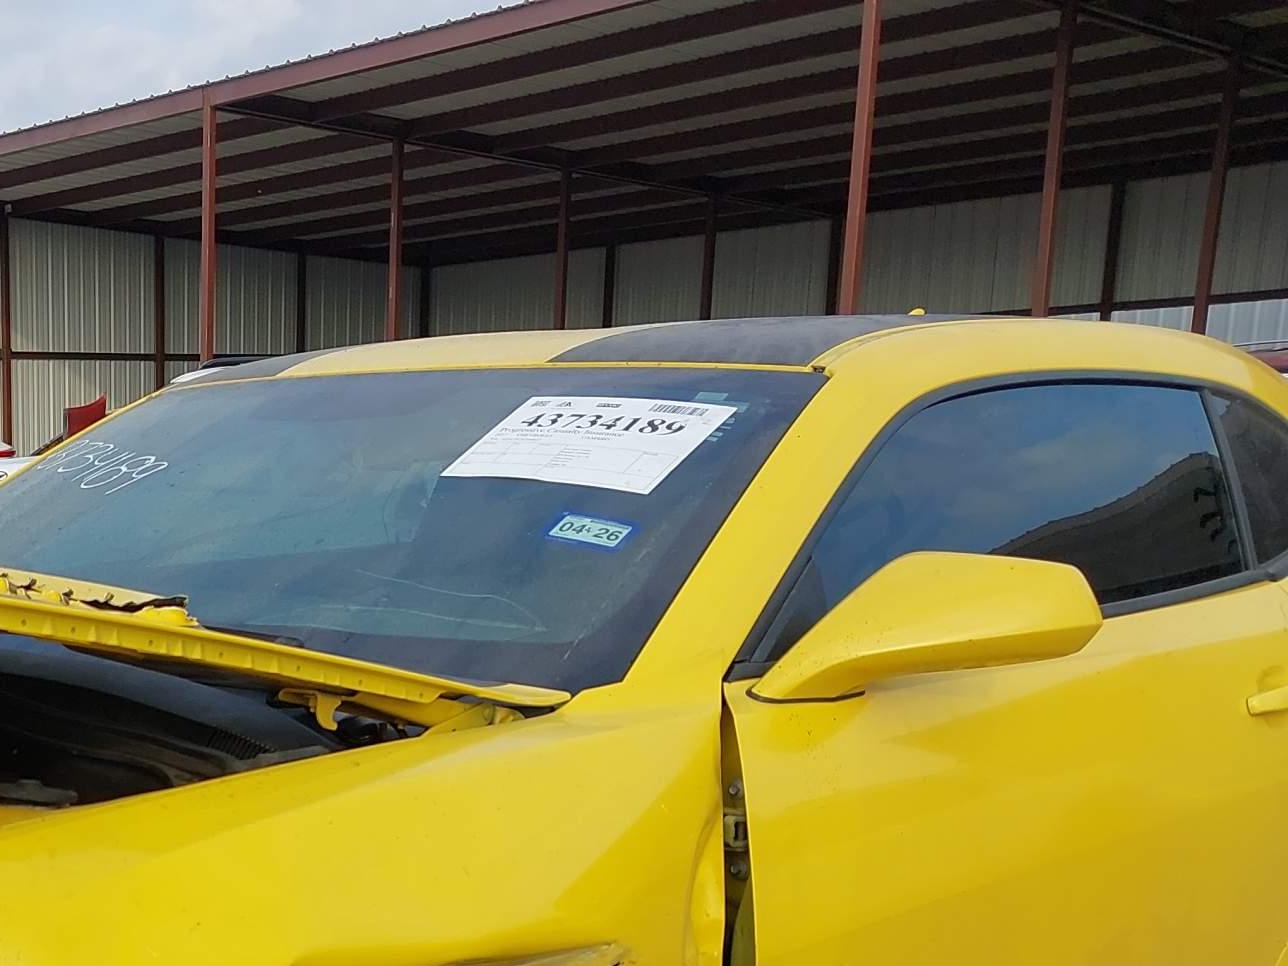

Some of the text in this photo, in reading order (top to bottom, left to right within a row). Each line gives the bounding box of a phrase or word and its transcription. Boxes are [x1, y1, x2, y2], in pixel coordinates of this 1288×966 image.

[520, 412, 688, 437] 43734189
[558, 521, 624, 542] 04 26
